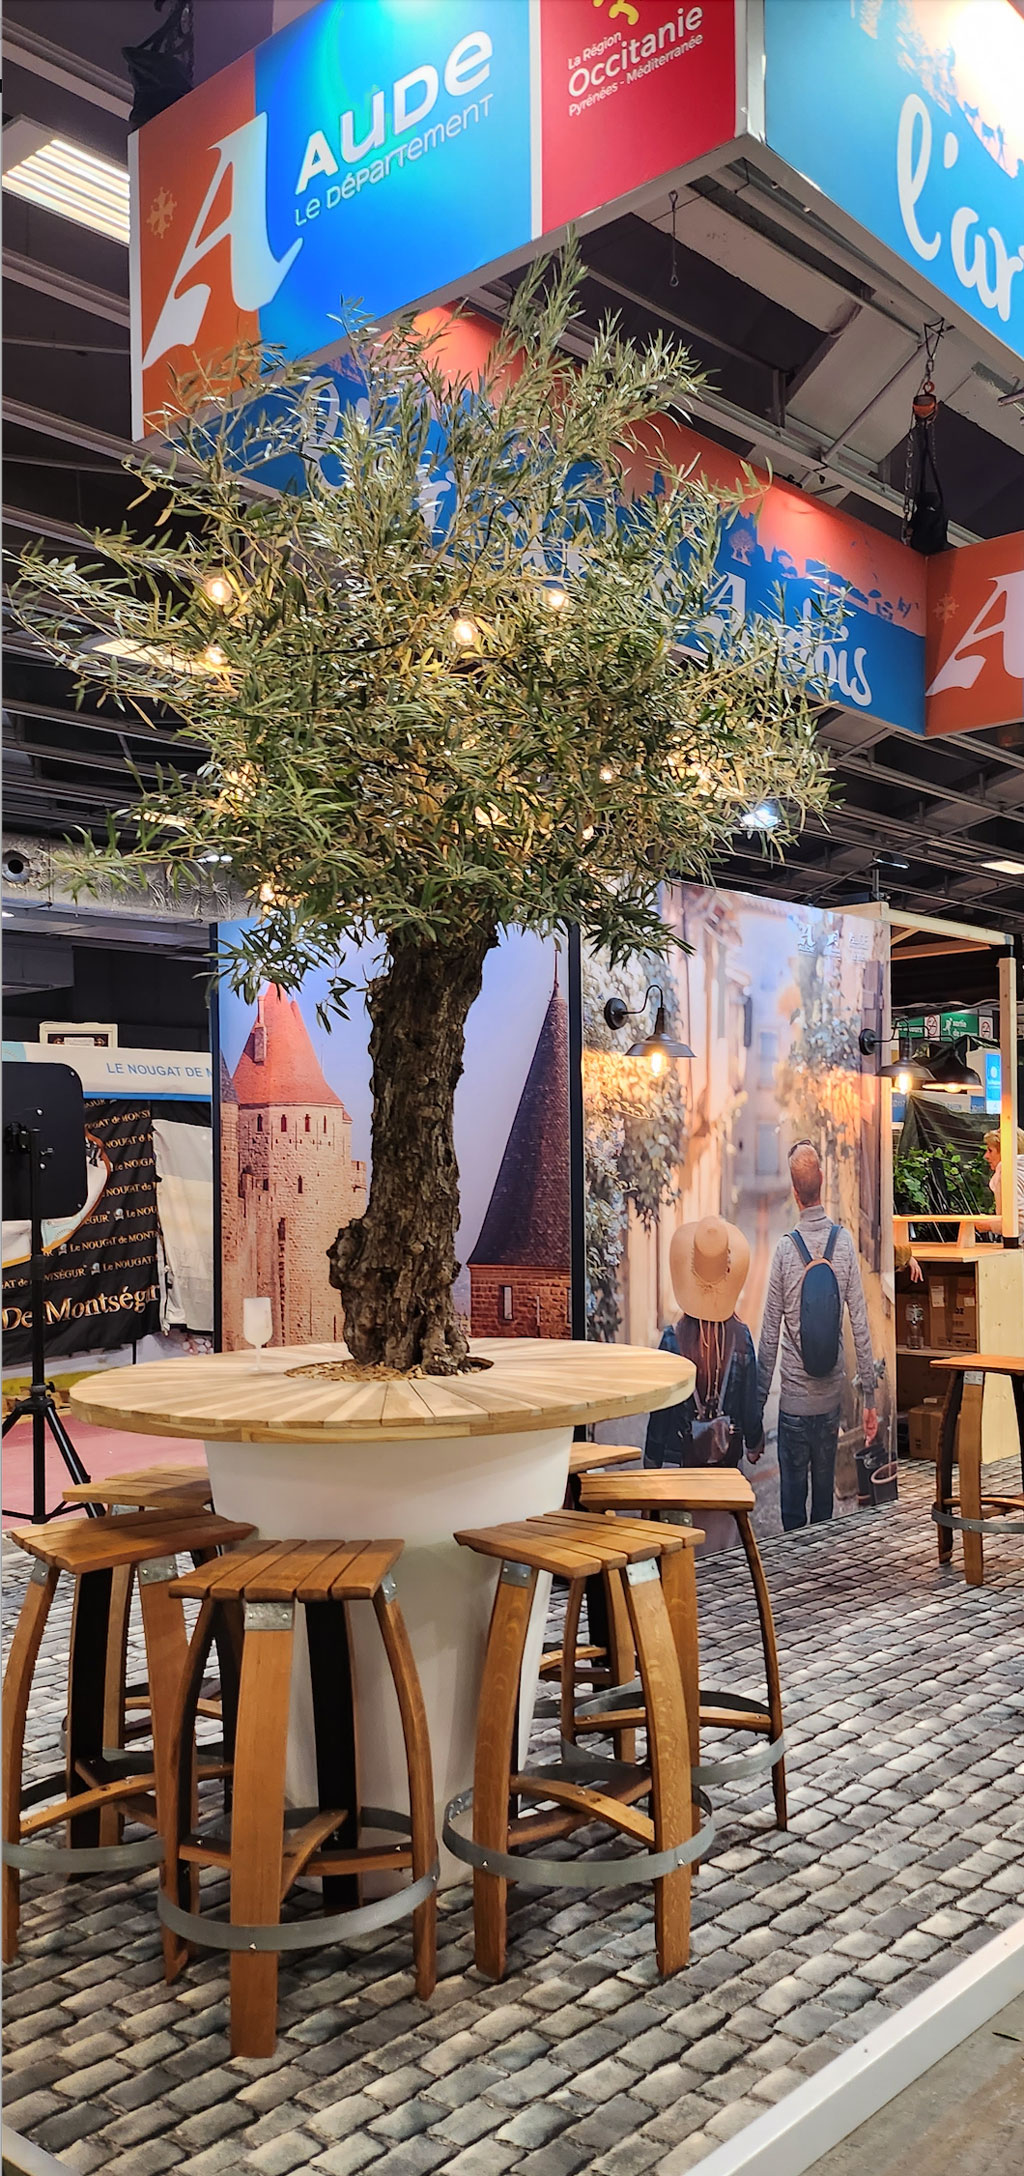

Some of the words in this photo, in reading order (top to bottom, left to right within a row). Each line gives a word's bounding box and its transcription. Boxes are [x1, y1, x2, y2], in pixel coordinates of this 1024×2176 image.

[568, 56, 581, 70] La
[583, 31, 622, 61] Région
[568, 6, 704, 98] Occitanie
[568, 82, 619, 117] Pyrénées
[626, 34, 704, 84] Méditerranée
[896, 93, 1024, 322] l'ar
[106, 1062, 125, 1075] LE
[127, 1063, 181, 1077] NOUGAT
[184, 1066, 204, 1078] DE
[69, 1242, 81, 1253] Le
[82, 1236, 118, 1251] NOUGAT
[102, 1262, 114, 1272] Le
